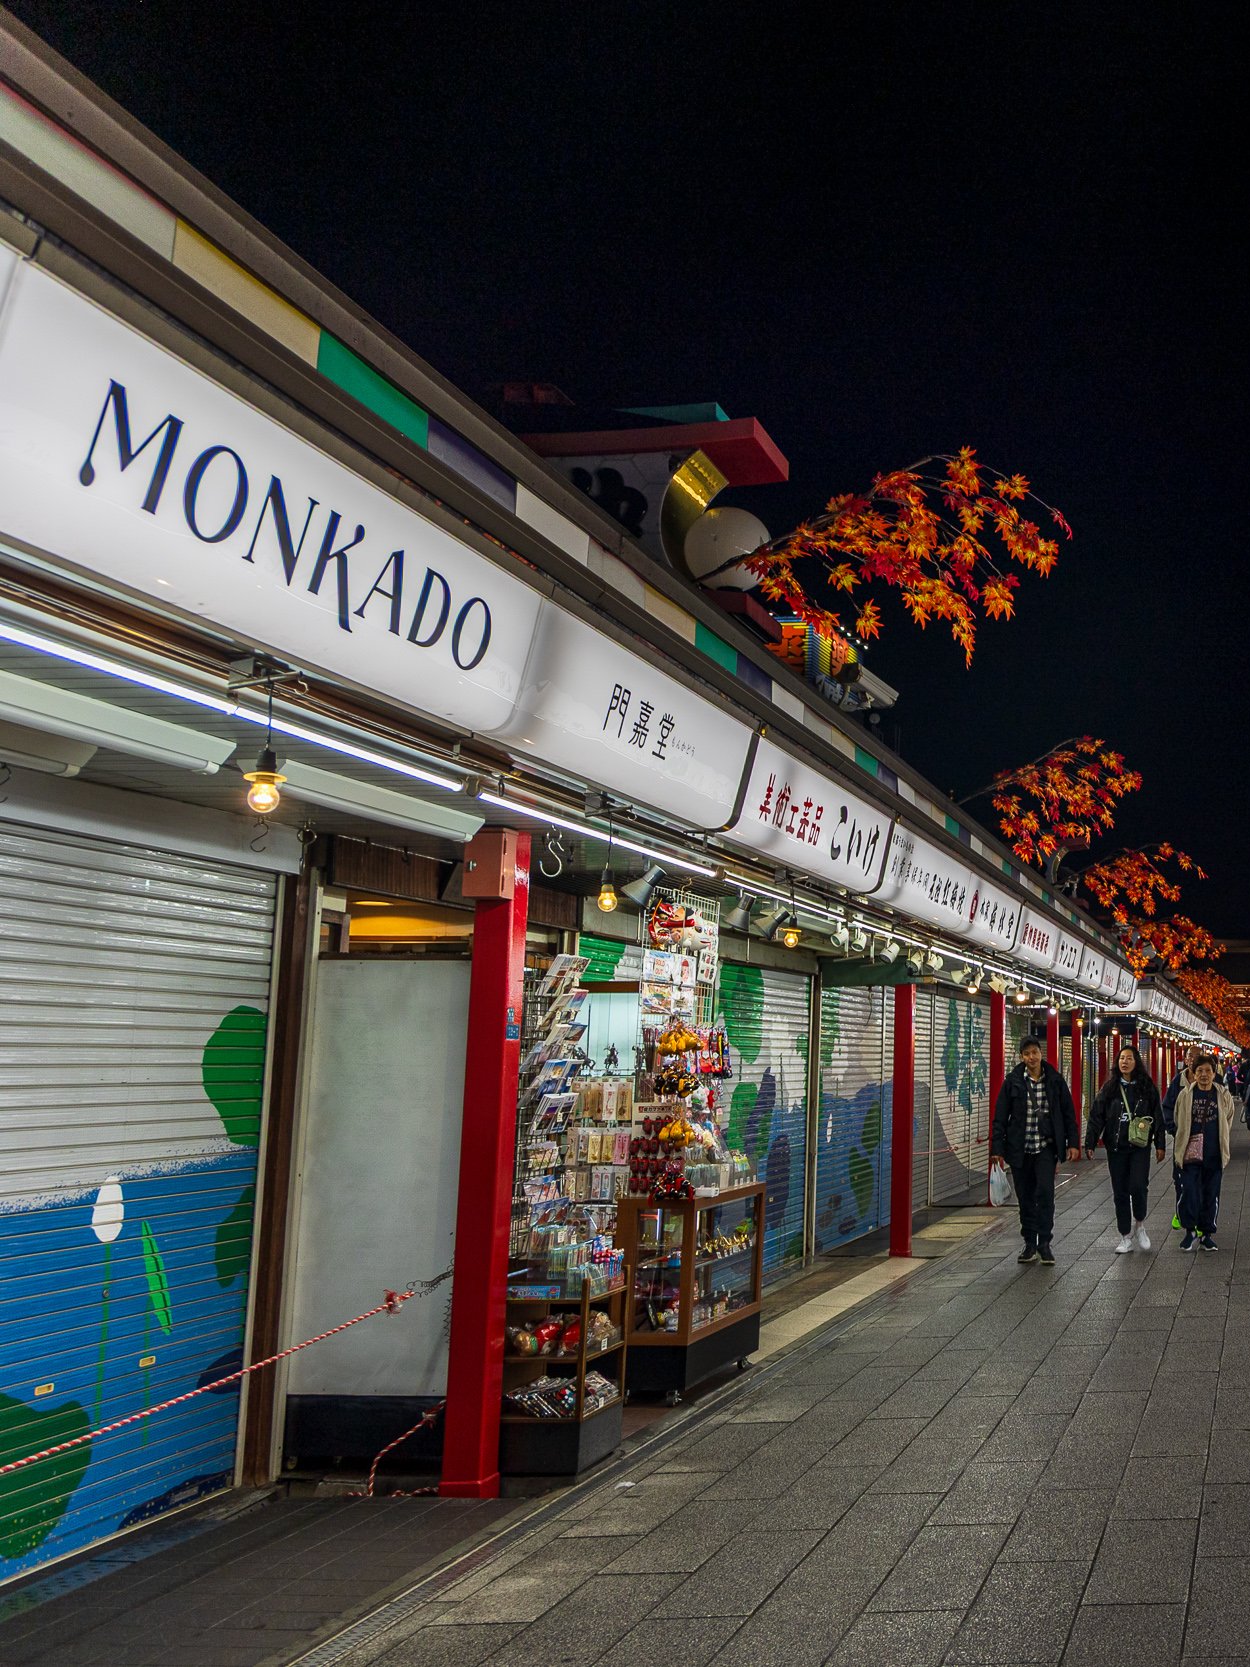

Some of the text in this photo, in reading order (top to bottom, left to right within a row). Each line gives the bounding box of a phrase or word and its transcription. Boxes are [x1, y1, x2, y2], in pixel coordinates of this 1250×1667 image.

[78, 378, 493, 672] MONKADO
[602, 682, 676, 761] 門嘉堂
[671, 736, 696, 757] もんかどう
[758, 772, 880, 877] 美術工芸品 こいけ
[655, 959, 666, 967] SOLD
